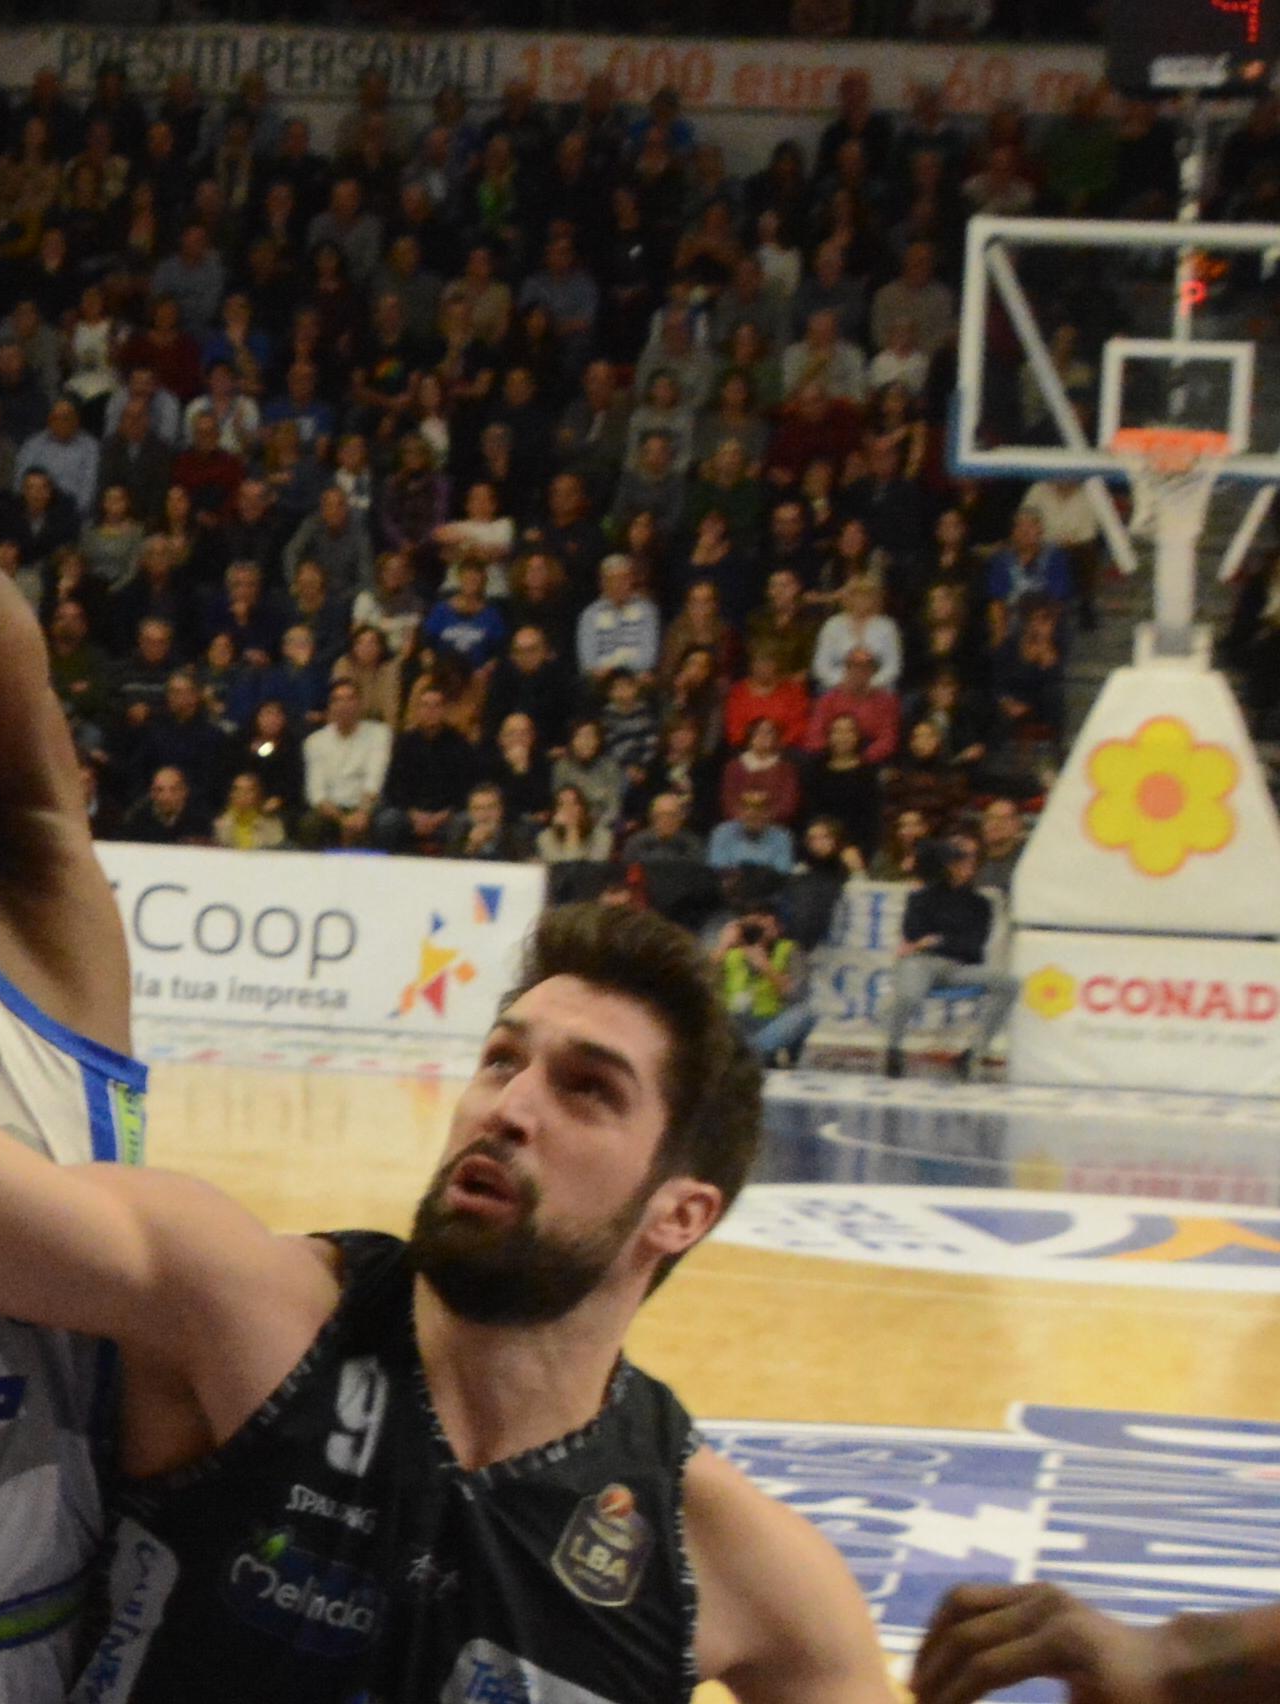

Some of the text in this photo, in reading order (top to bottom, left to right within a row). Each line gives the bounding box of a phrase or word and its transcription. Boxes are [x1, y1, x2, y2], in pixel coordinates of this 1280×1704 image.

[171, 976, 218, 1001] tua
[227, 976, 350, 1011] impresa
[1081, 974, 1279, 1022] CONAD
[326, 1354, 388, 1478] 9
[568, 1533, 629, 1585] LBA
